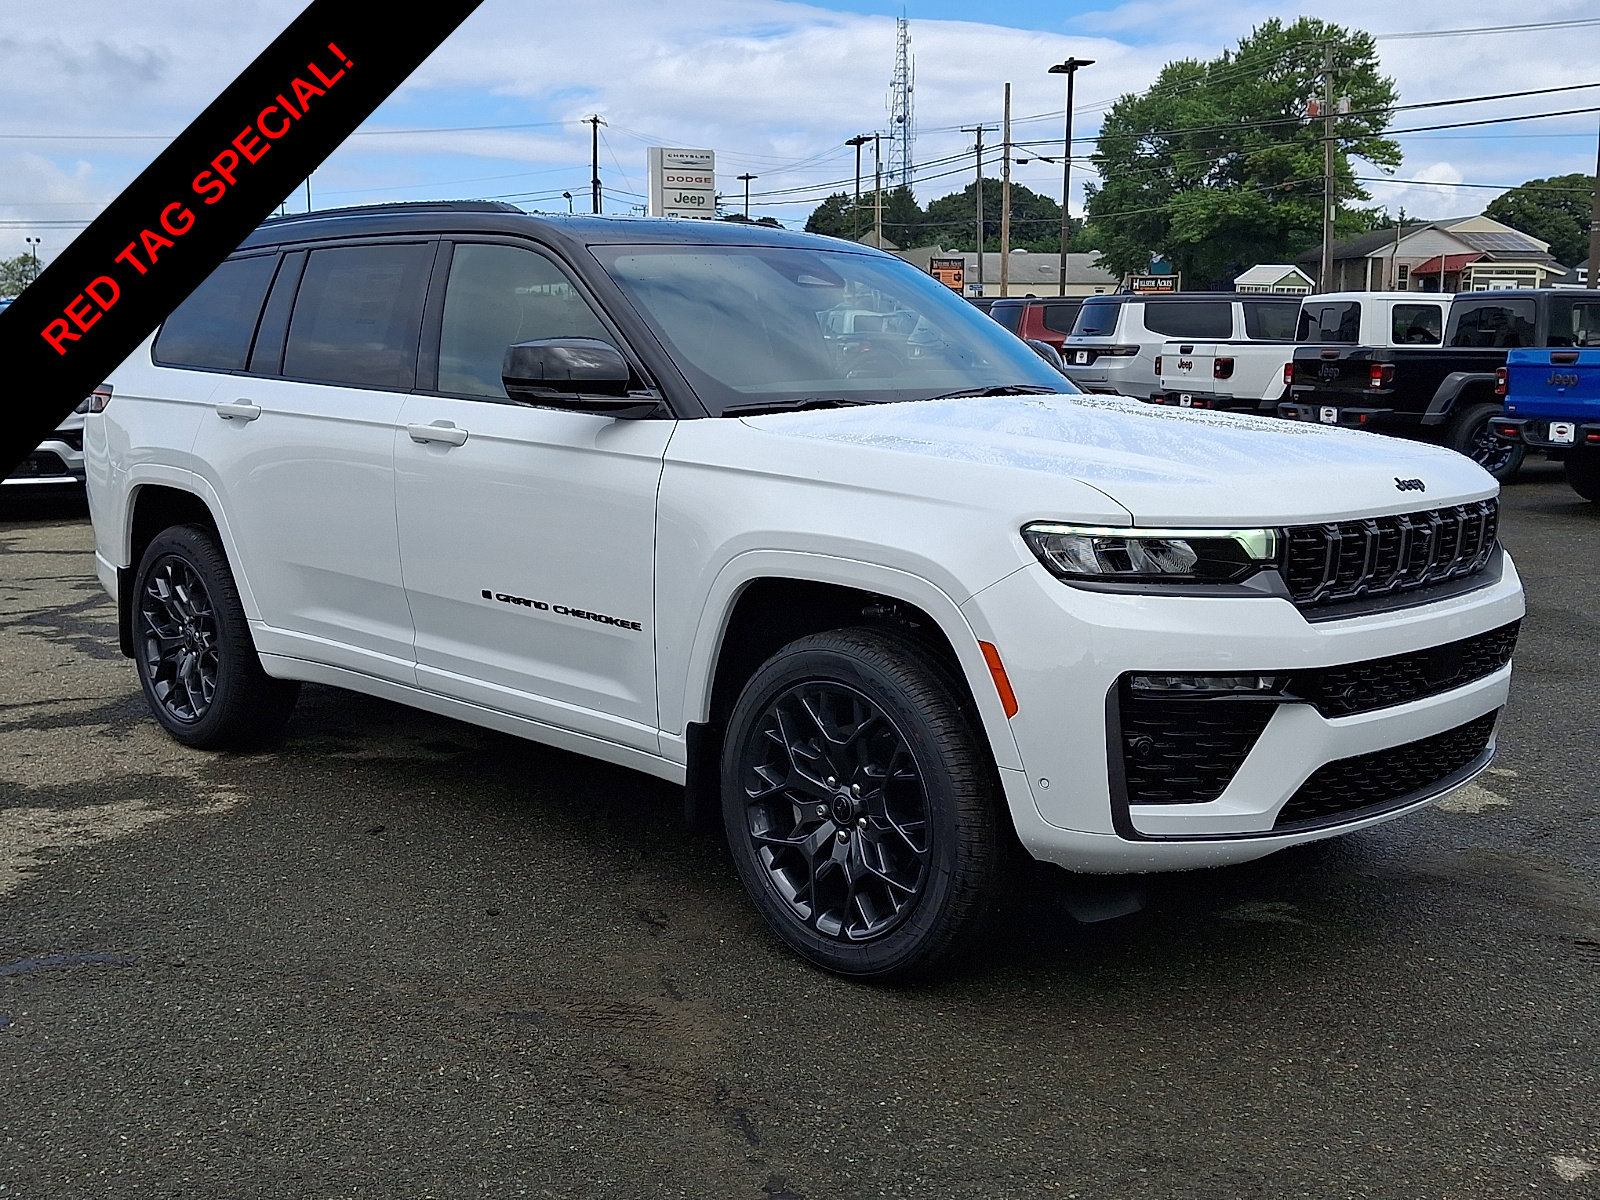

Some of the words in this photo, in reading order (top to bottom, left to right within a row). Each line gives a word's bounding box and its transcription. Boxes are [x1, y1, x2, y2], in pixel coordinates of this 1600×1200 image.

[674, 192, 705, 206] Jeep
[1178, 358, 1193, 371] Jeep
[1319, 363, 1340, 379] Jeep
[1547, 370, 1578, 387] Jeep
[1394, 477, 1425, 492] Jeep
[495, 593, 549, 611] GRAND
[553, 605, 642, 631] CHEROKEE
